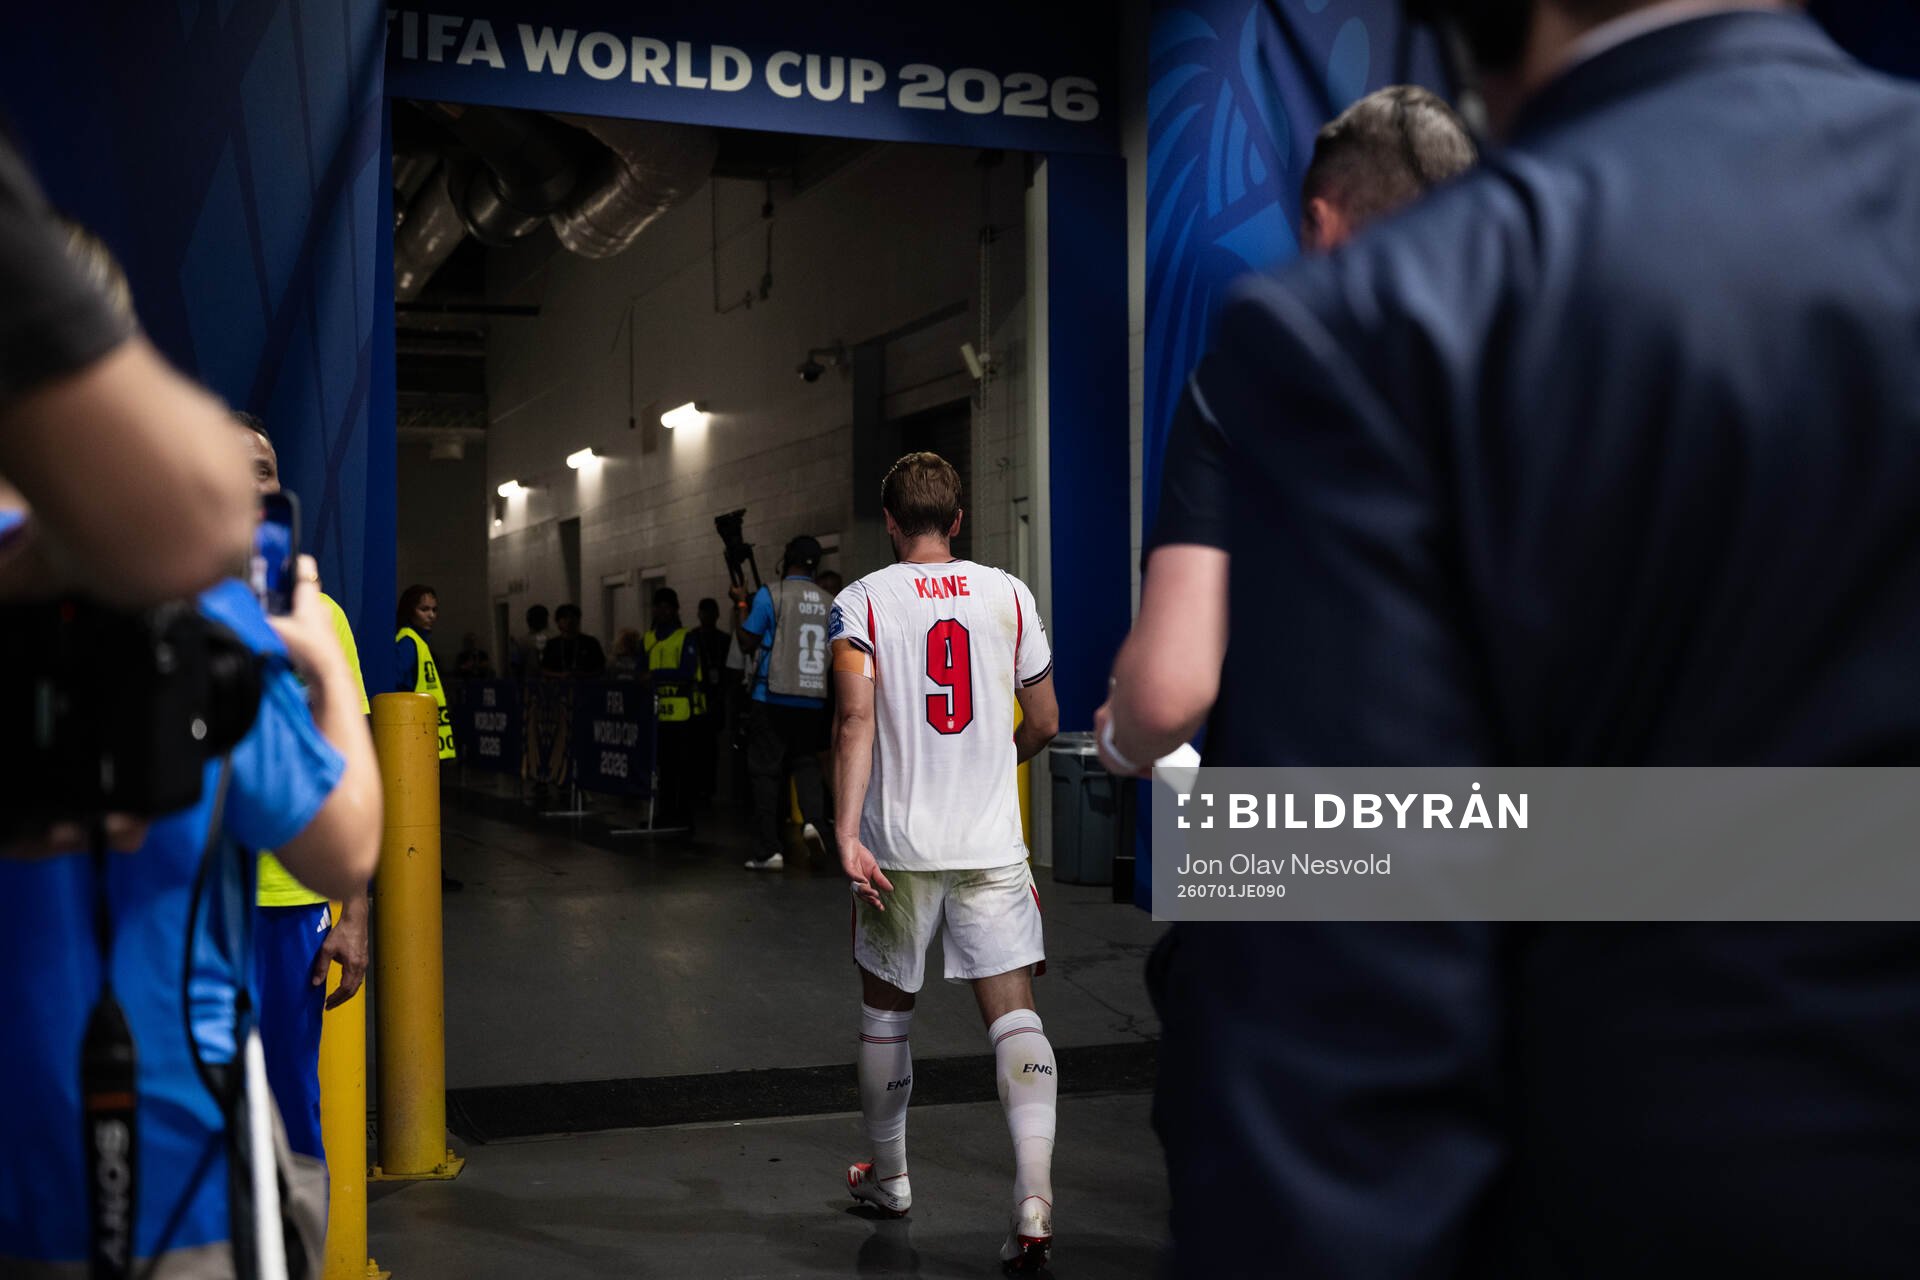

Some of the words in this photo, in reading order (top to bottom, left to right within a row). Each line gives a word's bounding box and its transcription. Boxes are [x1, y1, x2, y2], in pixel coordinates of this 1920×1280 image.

[516, 23, 753, 92] WORLD
[765, 50, 887, 104] CUP
[898, 63, 1100, 122] 2026
[803, 590, 820, 602] HB
[914, 575, 971, 600] KANE
[926, 618, 974, 735] 9
[600, 750, 629, 778] 2026
[1022, 1062, 1053, 1077] ENG
[886, 1075, 912, 1091] ENG
